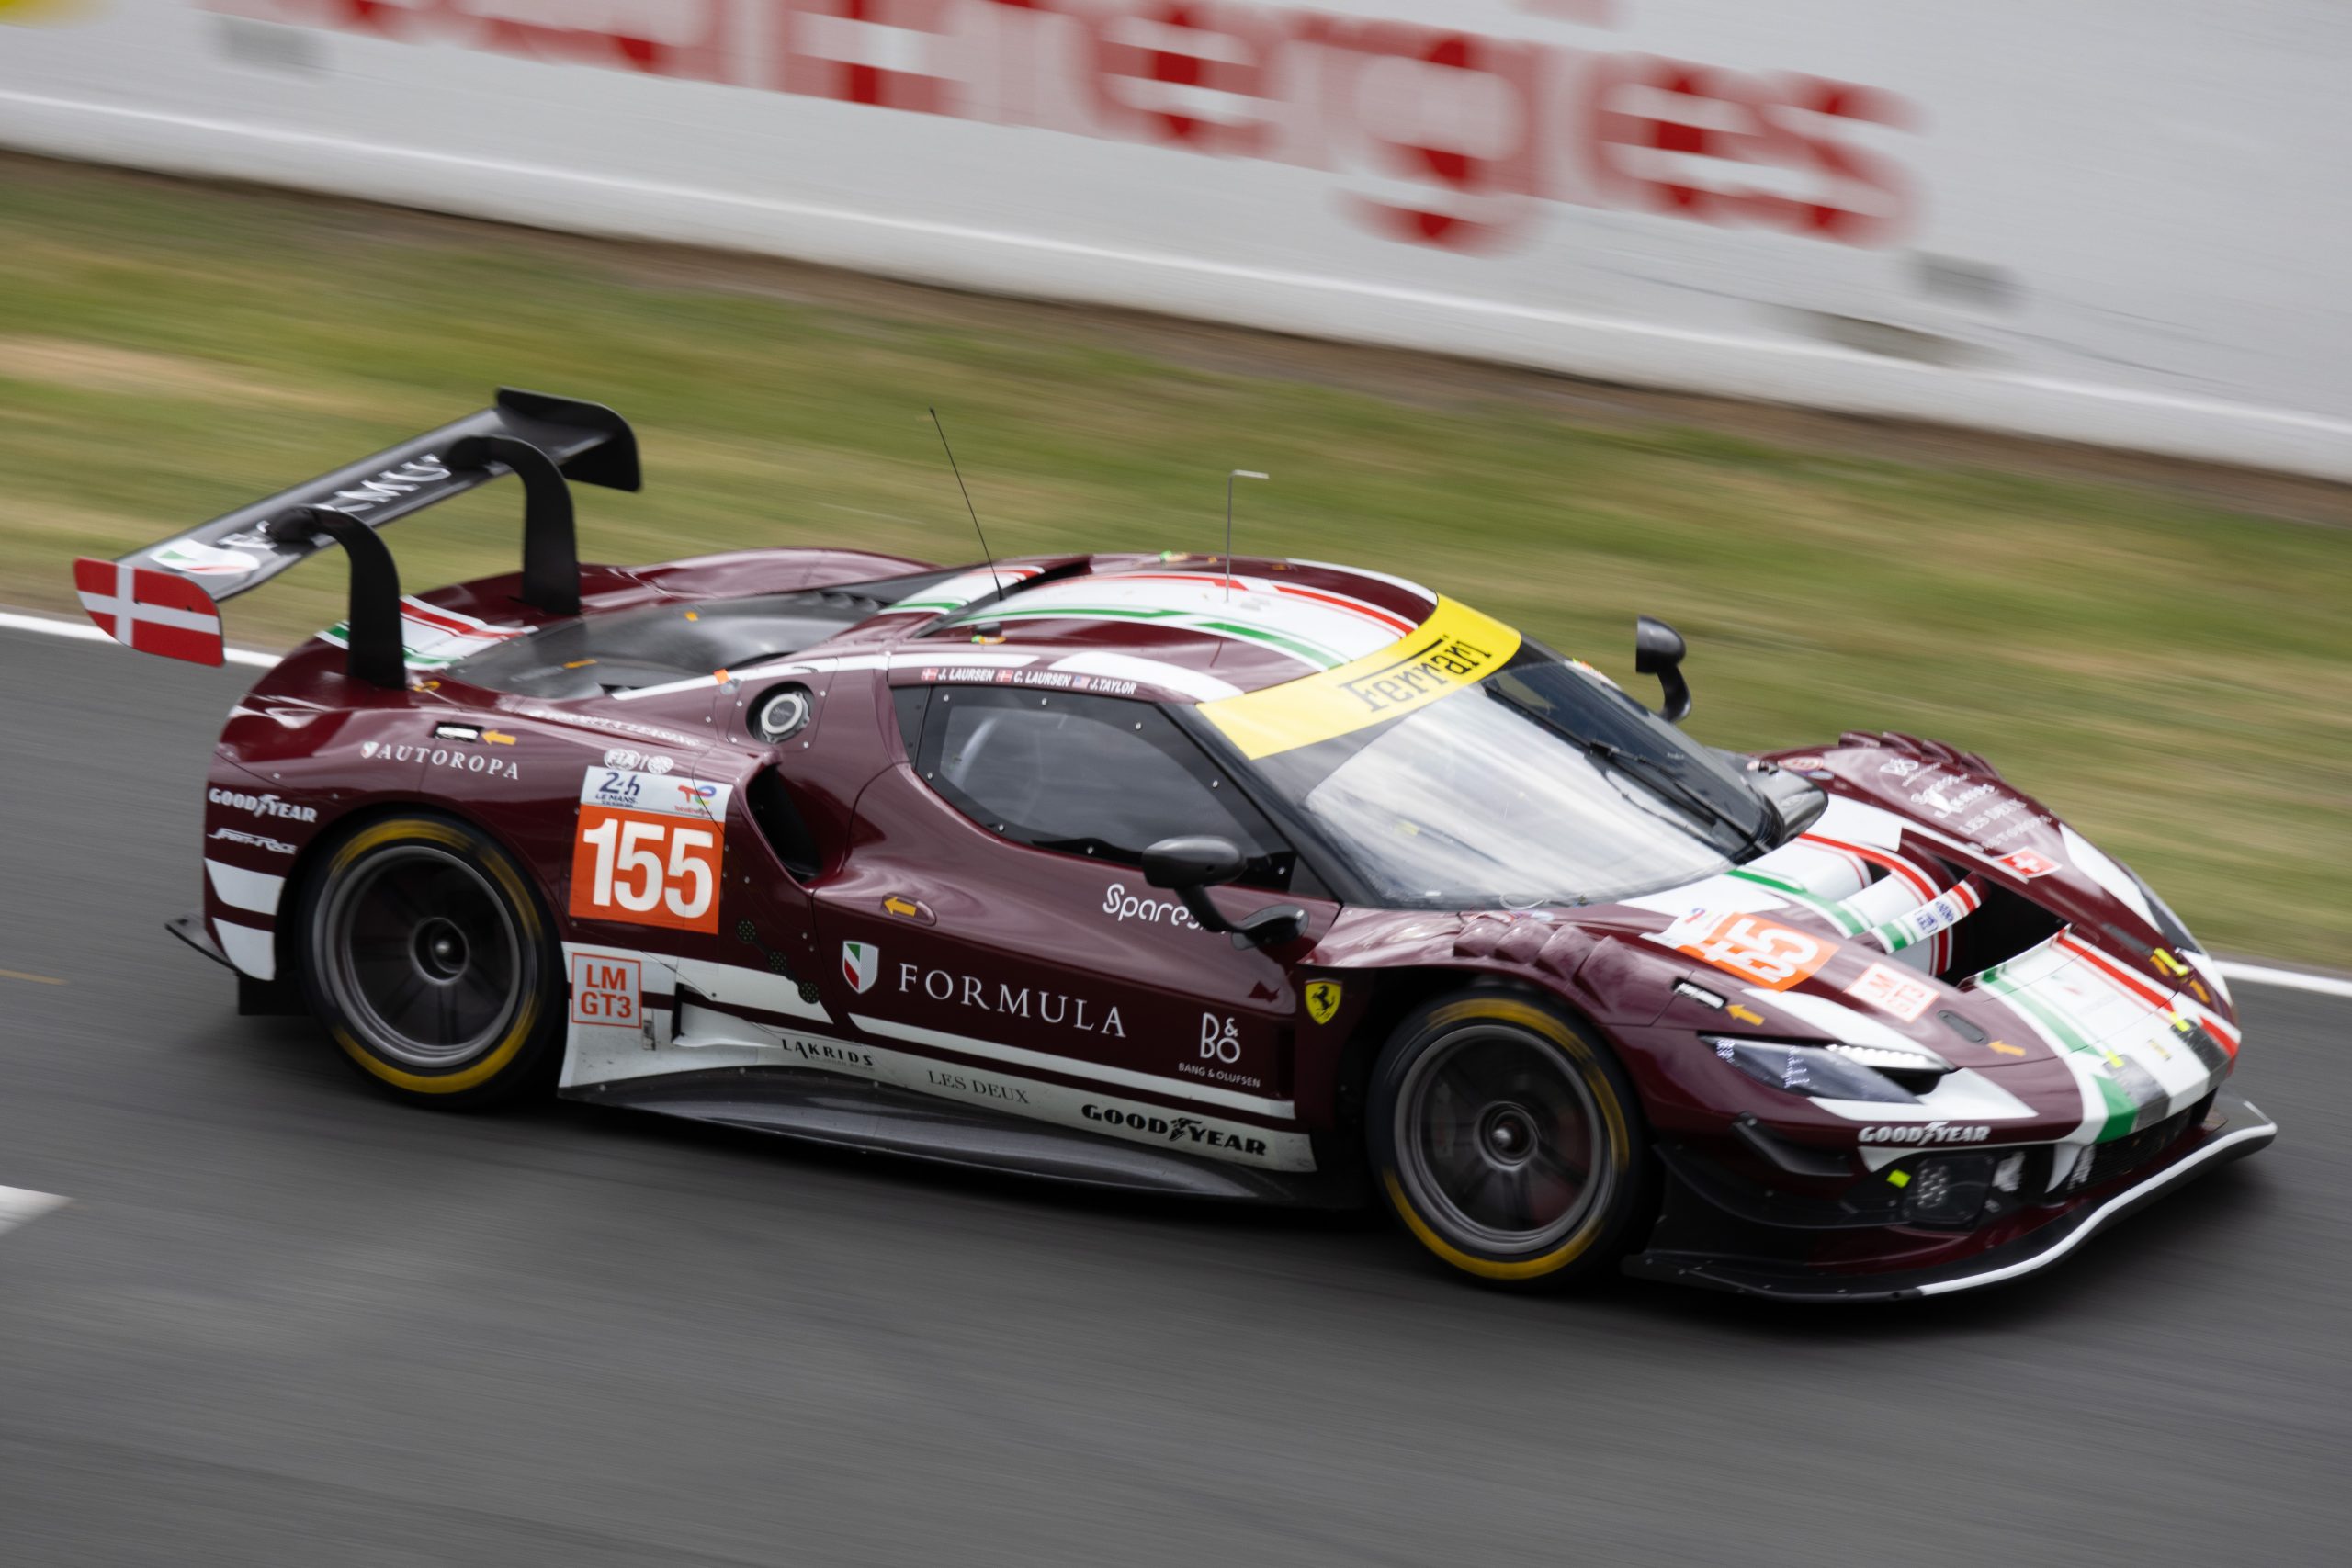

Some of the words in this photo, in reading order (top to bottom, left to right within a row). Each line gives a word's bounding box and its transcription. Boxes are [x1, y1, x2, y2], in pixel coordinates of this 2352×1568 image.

[949, 669, 996, 682] LAURSEN
[1025, 673, 1072, 687] LAURSEN
[1338, 634, 1492, 714] Ferrari
[377, 742, 520, 780] AUTOROPA
[208, 788, 318, 822] GOODYEAR
[582, 818, 714, 919] 155
[586, 964, 627, 991] LM
[580, 991, 632, 1019] GT3
[899, 962, 1127, 1039] FORMULA
[781, 1038, 874, 1066] LAKRIDS
[926, 1069, 967, 1090] LES
[970, 1079, 1031, 1104] DEUX
[1178, 1062, 1206, 1077] BANG
[1216, 1070, 1261, 1089] OLUFSEN
[1081, 1103, 1268, 1157] GOODYEAR
[1858, 1122, 1992, 1146] GOODYEAR
